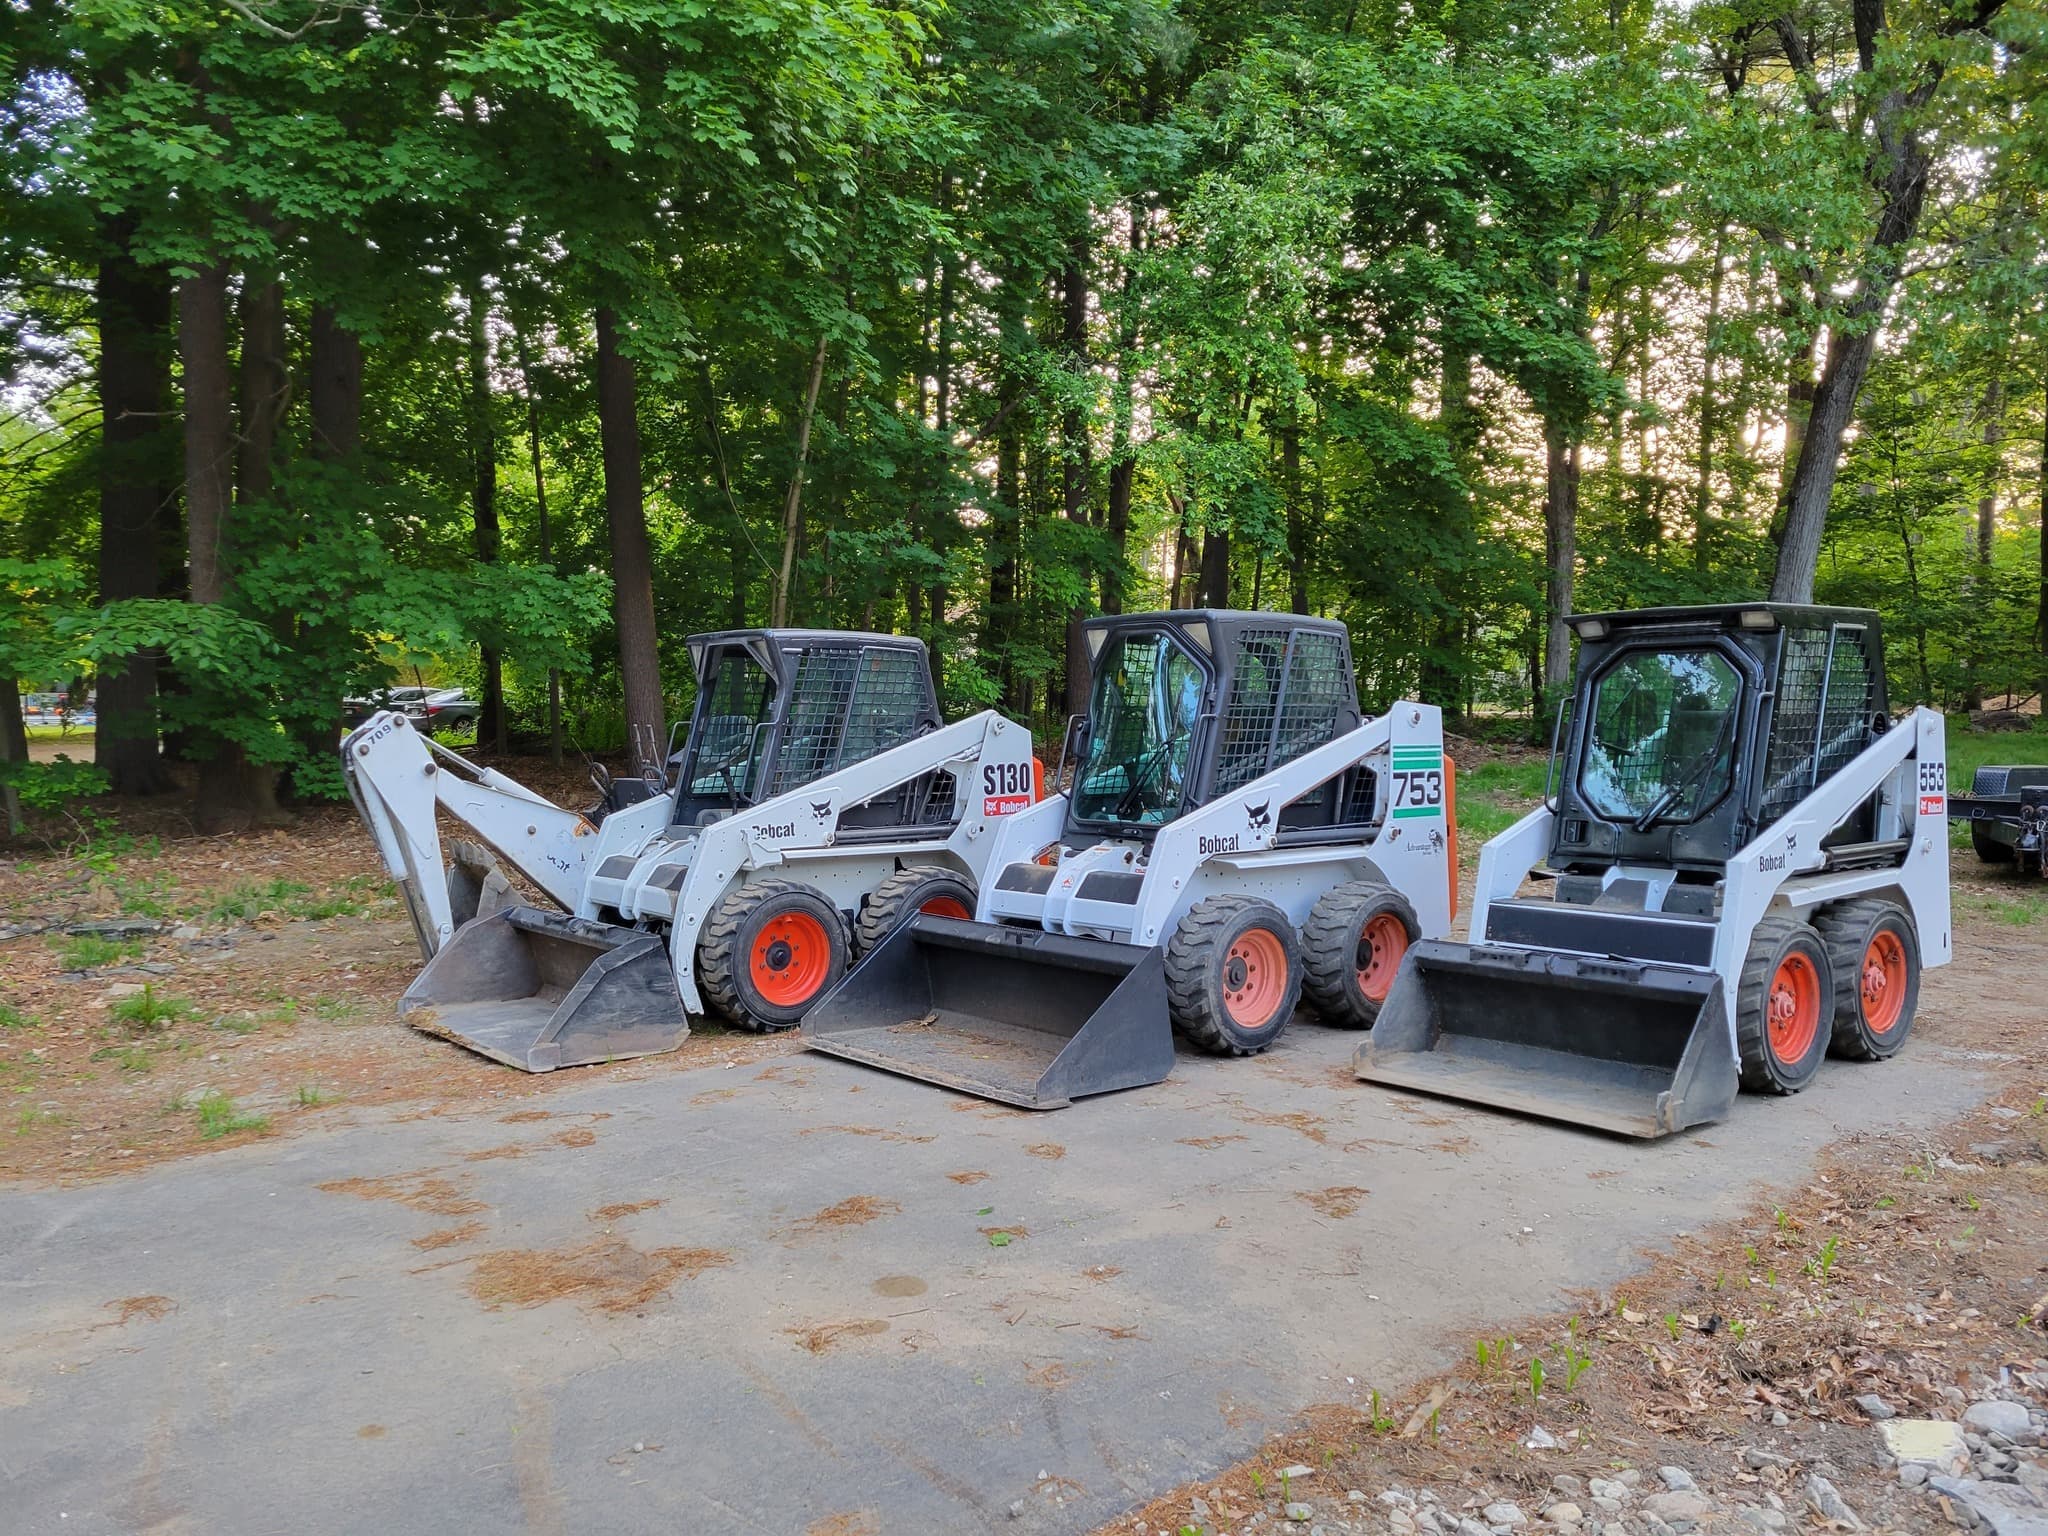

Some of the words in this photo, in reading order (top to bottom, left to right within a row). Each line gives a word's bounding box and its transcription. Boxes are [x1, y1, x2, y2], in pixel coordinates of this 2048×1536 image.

[368, 724, 392, 745] 709
[983, 762, 1030, 795] S130
[1392, 771, 1441, 807] 753
[1920, 762, 1945, 791] 553
[1199, 832, 1239, 855] Bobcat
[1759, 853, 1786, 872] Bobcat
